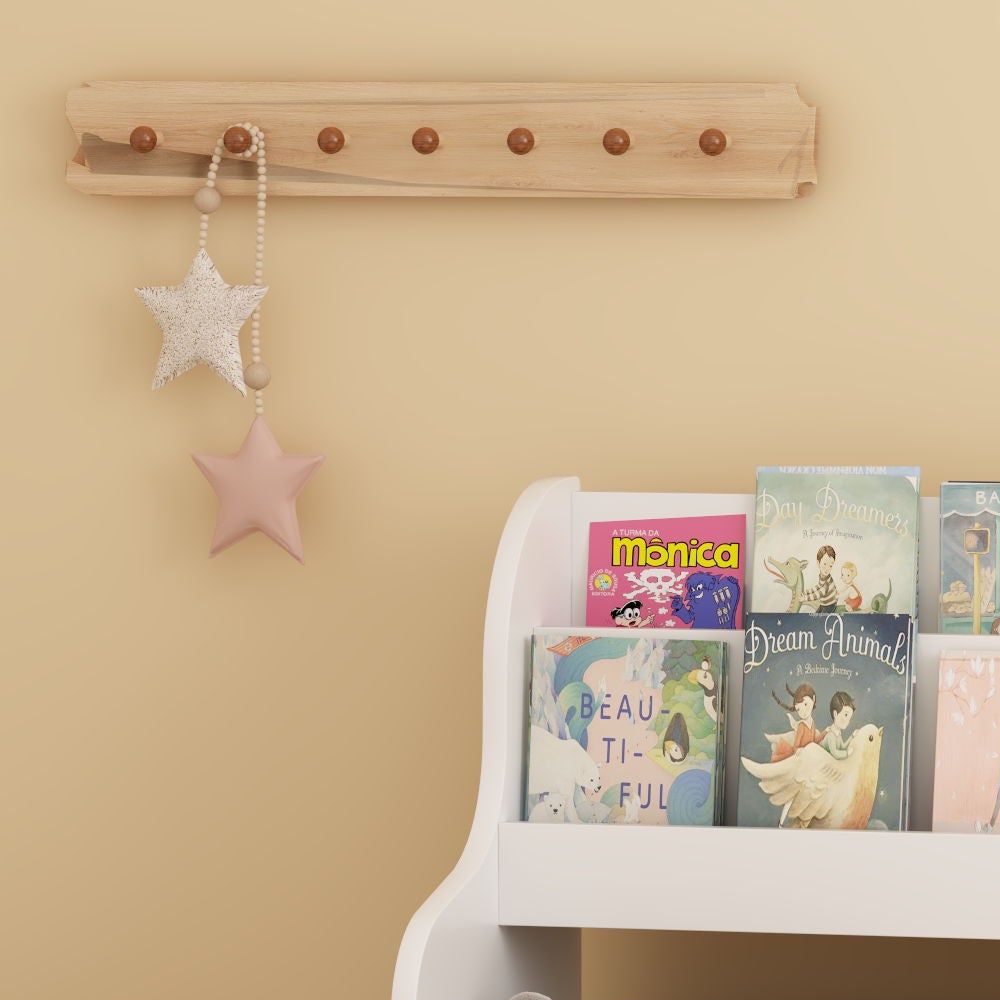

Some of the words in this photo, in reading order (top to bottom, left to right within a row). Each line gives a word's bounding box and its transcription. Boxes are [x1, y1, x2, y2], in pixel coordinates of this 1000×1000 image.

[756, 487, 803, 531] Day
[812, 481, 908, 537] Dreamers
[648, 529, 660, 537] DA
[744, 620, 817, 674] Dream
[822, 613, 907, 675] Animals
[619, 782, 667, 809] FUL
